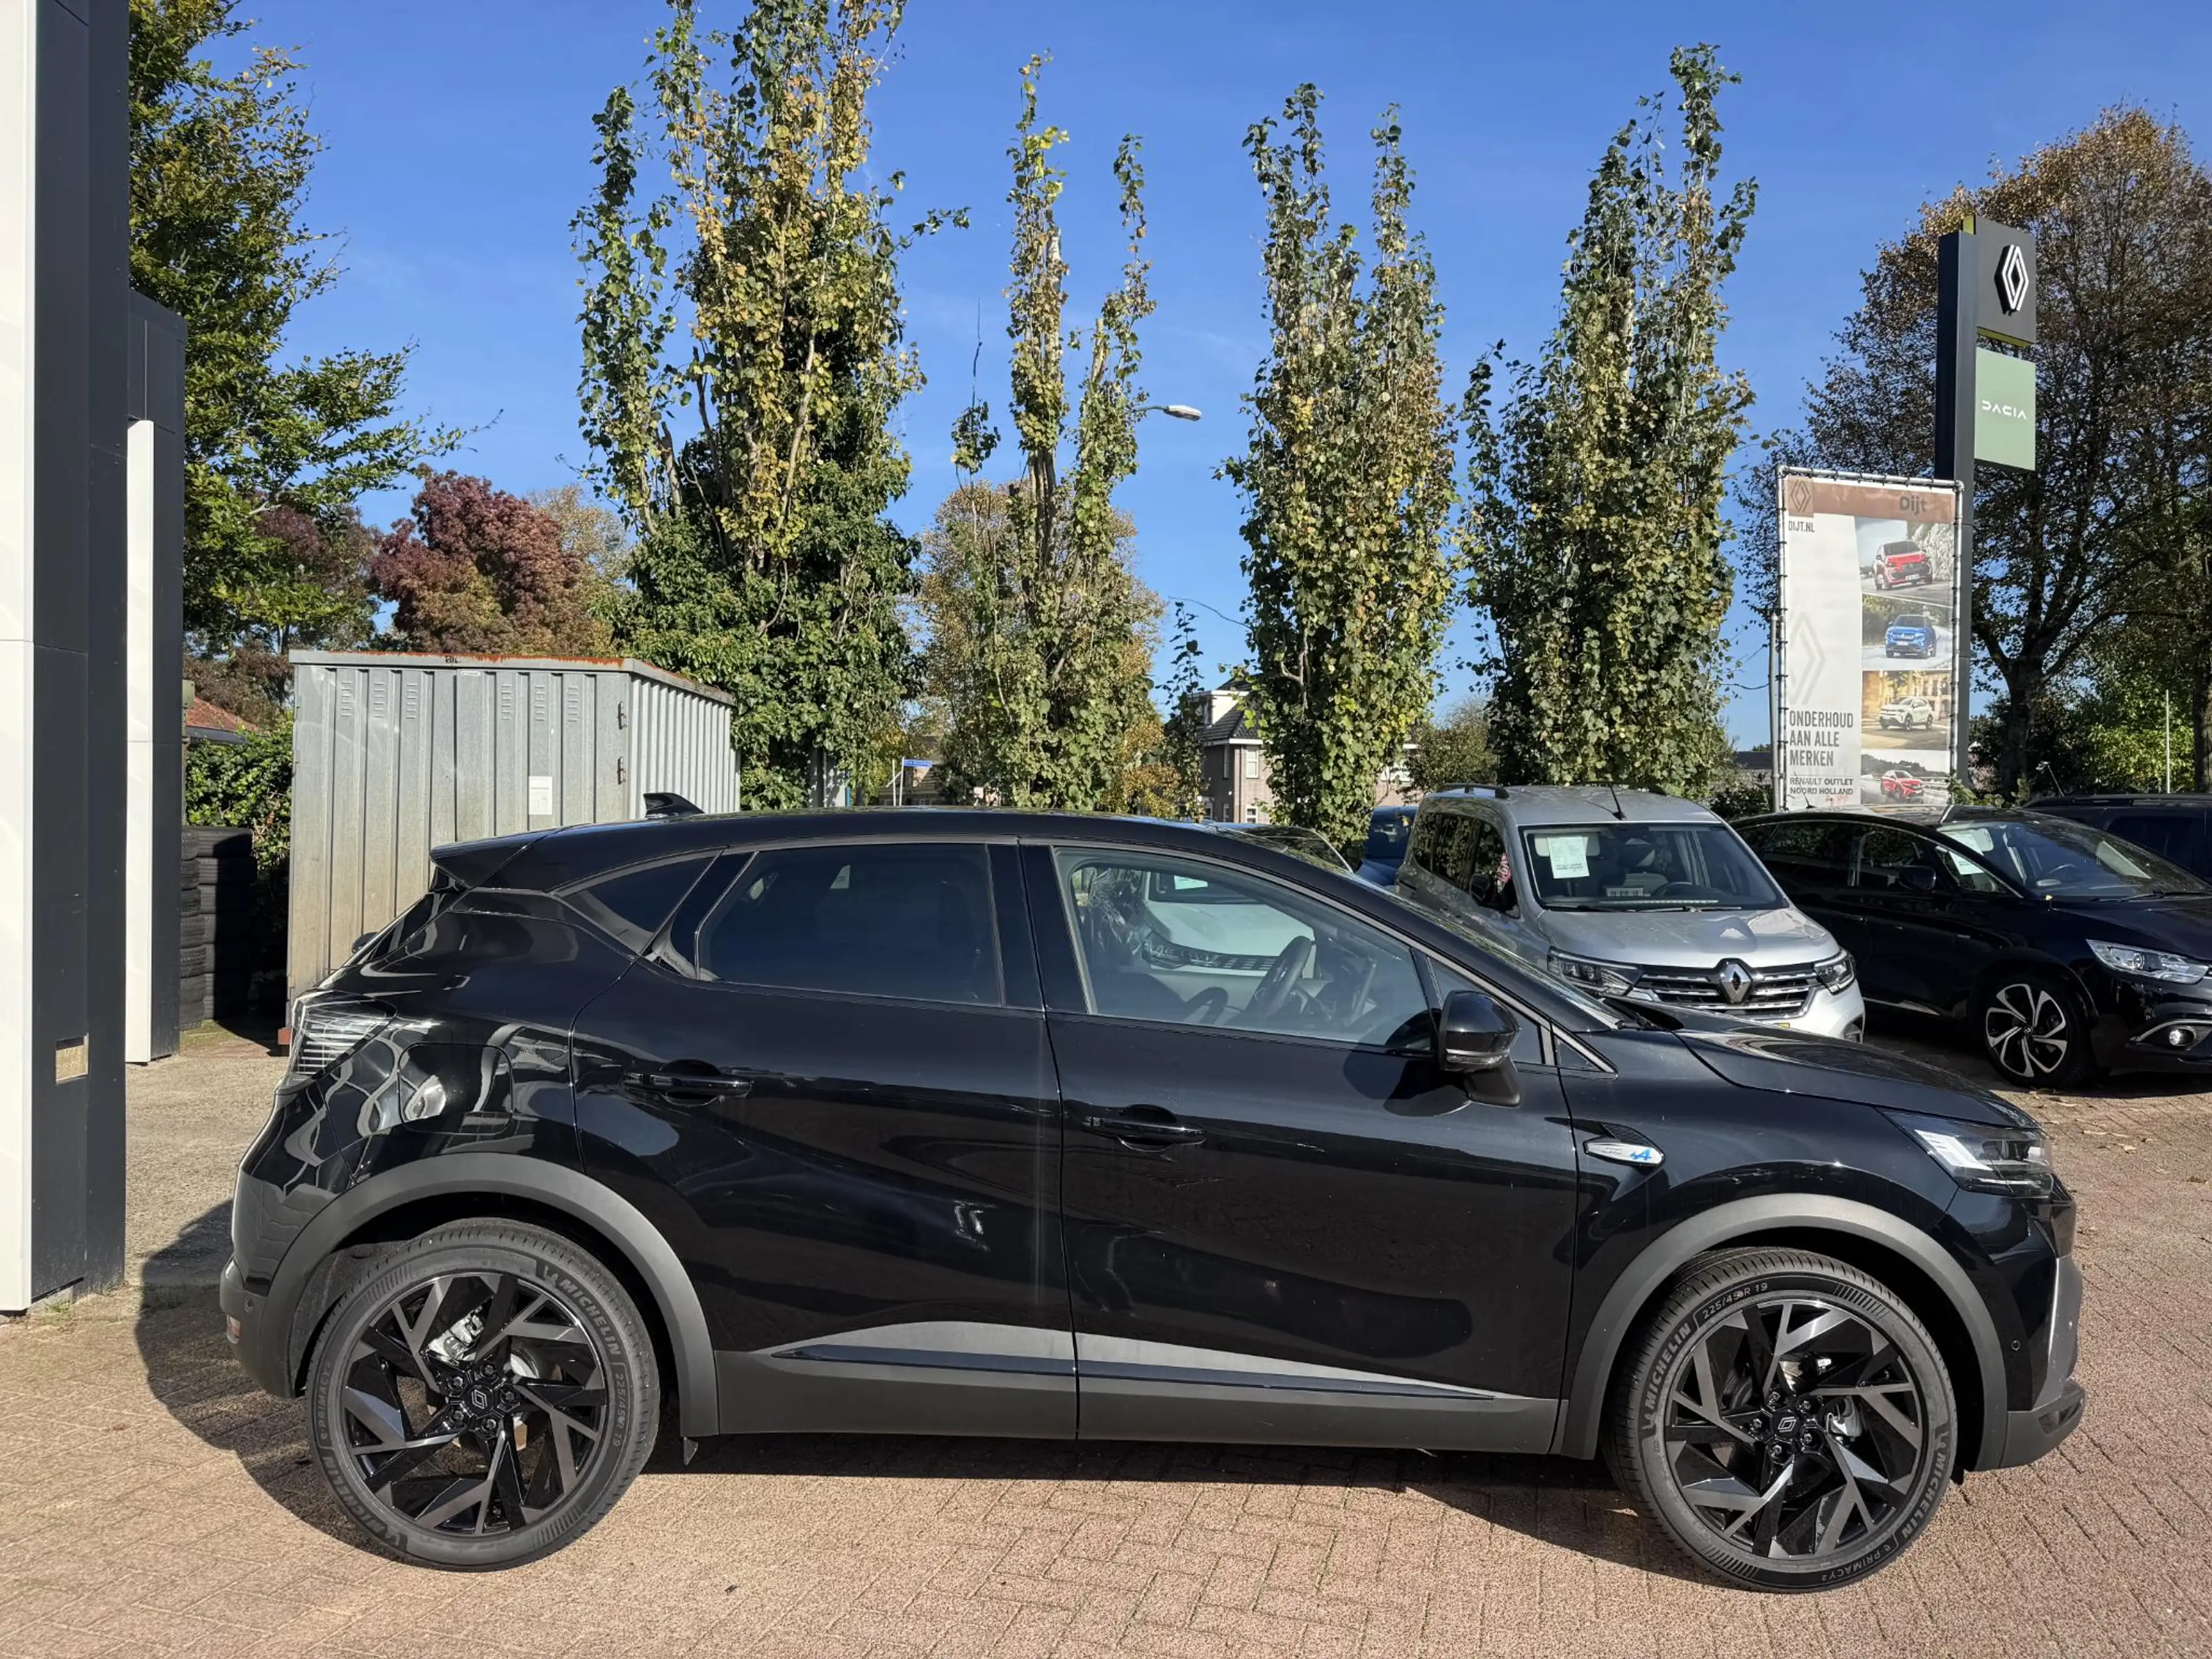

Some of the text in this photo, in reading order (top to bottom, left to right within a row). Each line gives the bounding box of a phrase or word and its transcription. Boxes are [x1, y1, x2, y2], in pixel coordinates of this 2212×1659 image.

[1982, 400, 2027, 419] DACIA
[1900, 495, 1927, 516] Dijt
[1789, 520, 1815, 533] DIJT.NL
[1789, 710, 1853, 728] ONDERHOUD
[1790, 730, 1839, 747] AAN ALLE
[1790, 749, 1834, 766] MERKEN
[1755, 1282, 1768, 1292] 19
[559, 1278, 622, 1355] MICHELIN
[1645, 1323, 1692, 1410] MICHELIN
[323, 1456, 385, 1533] MICHELIN
[1901, 1452, 1946, 1539] MICHELIN
